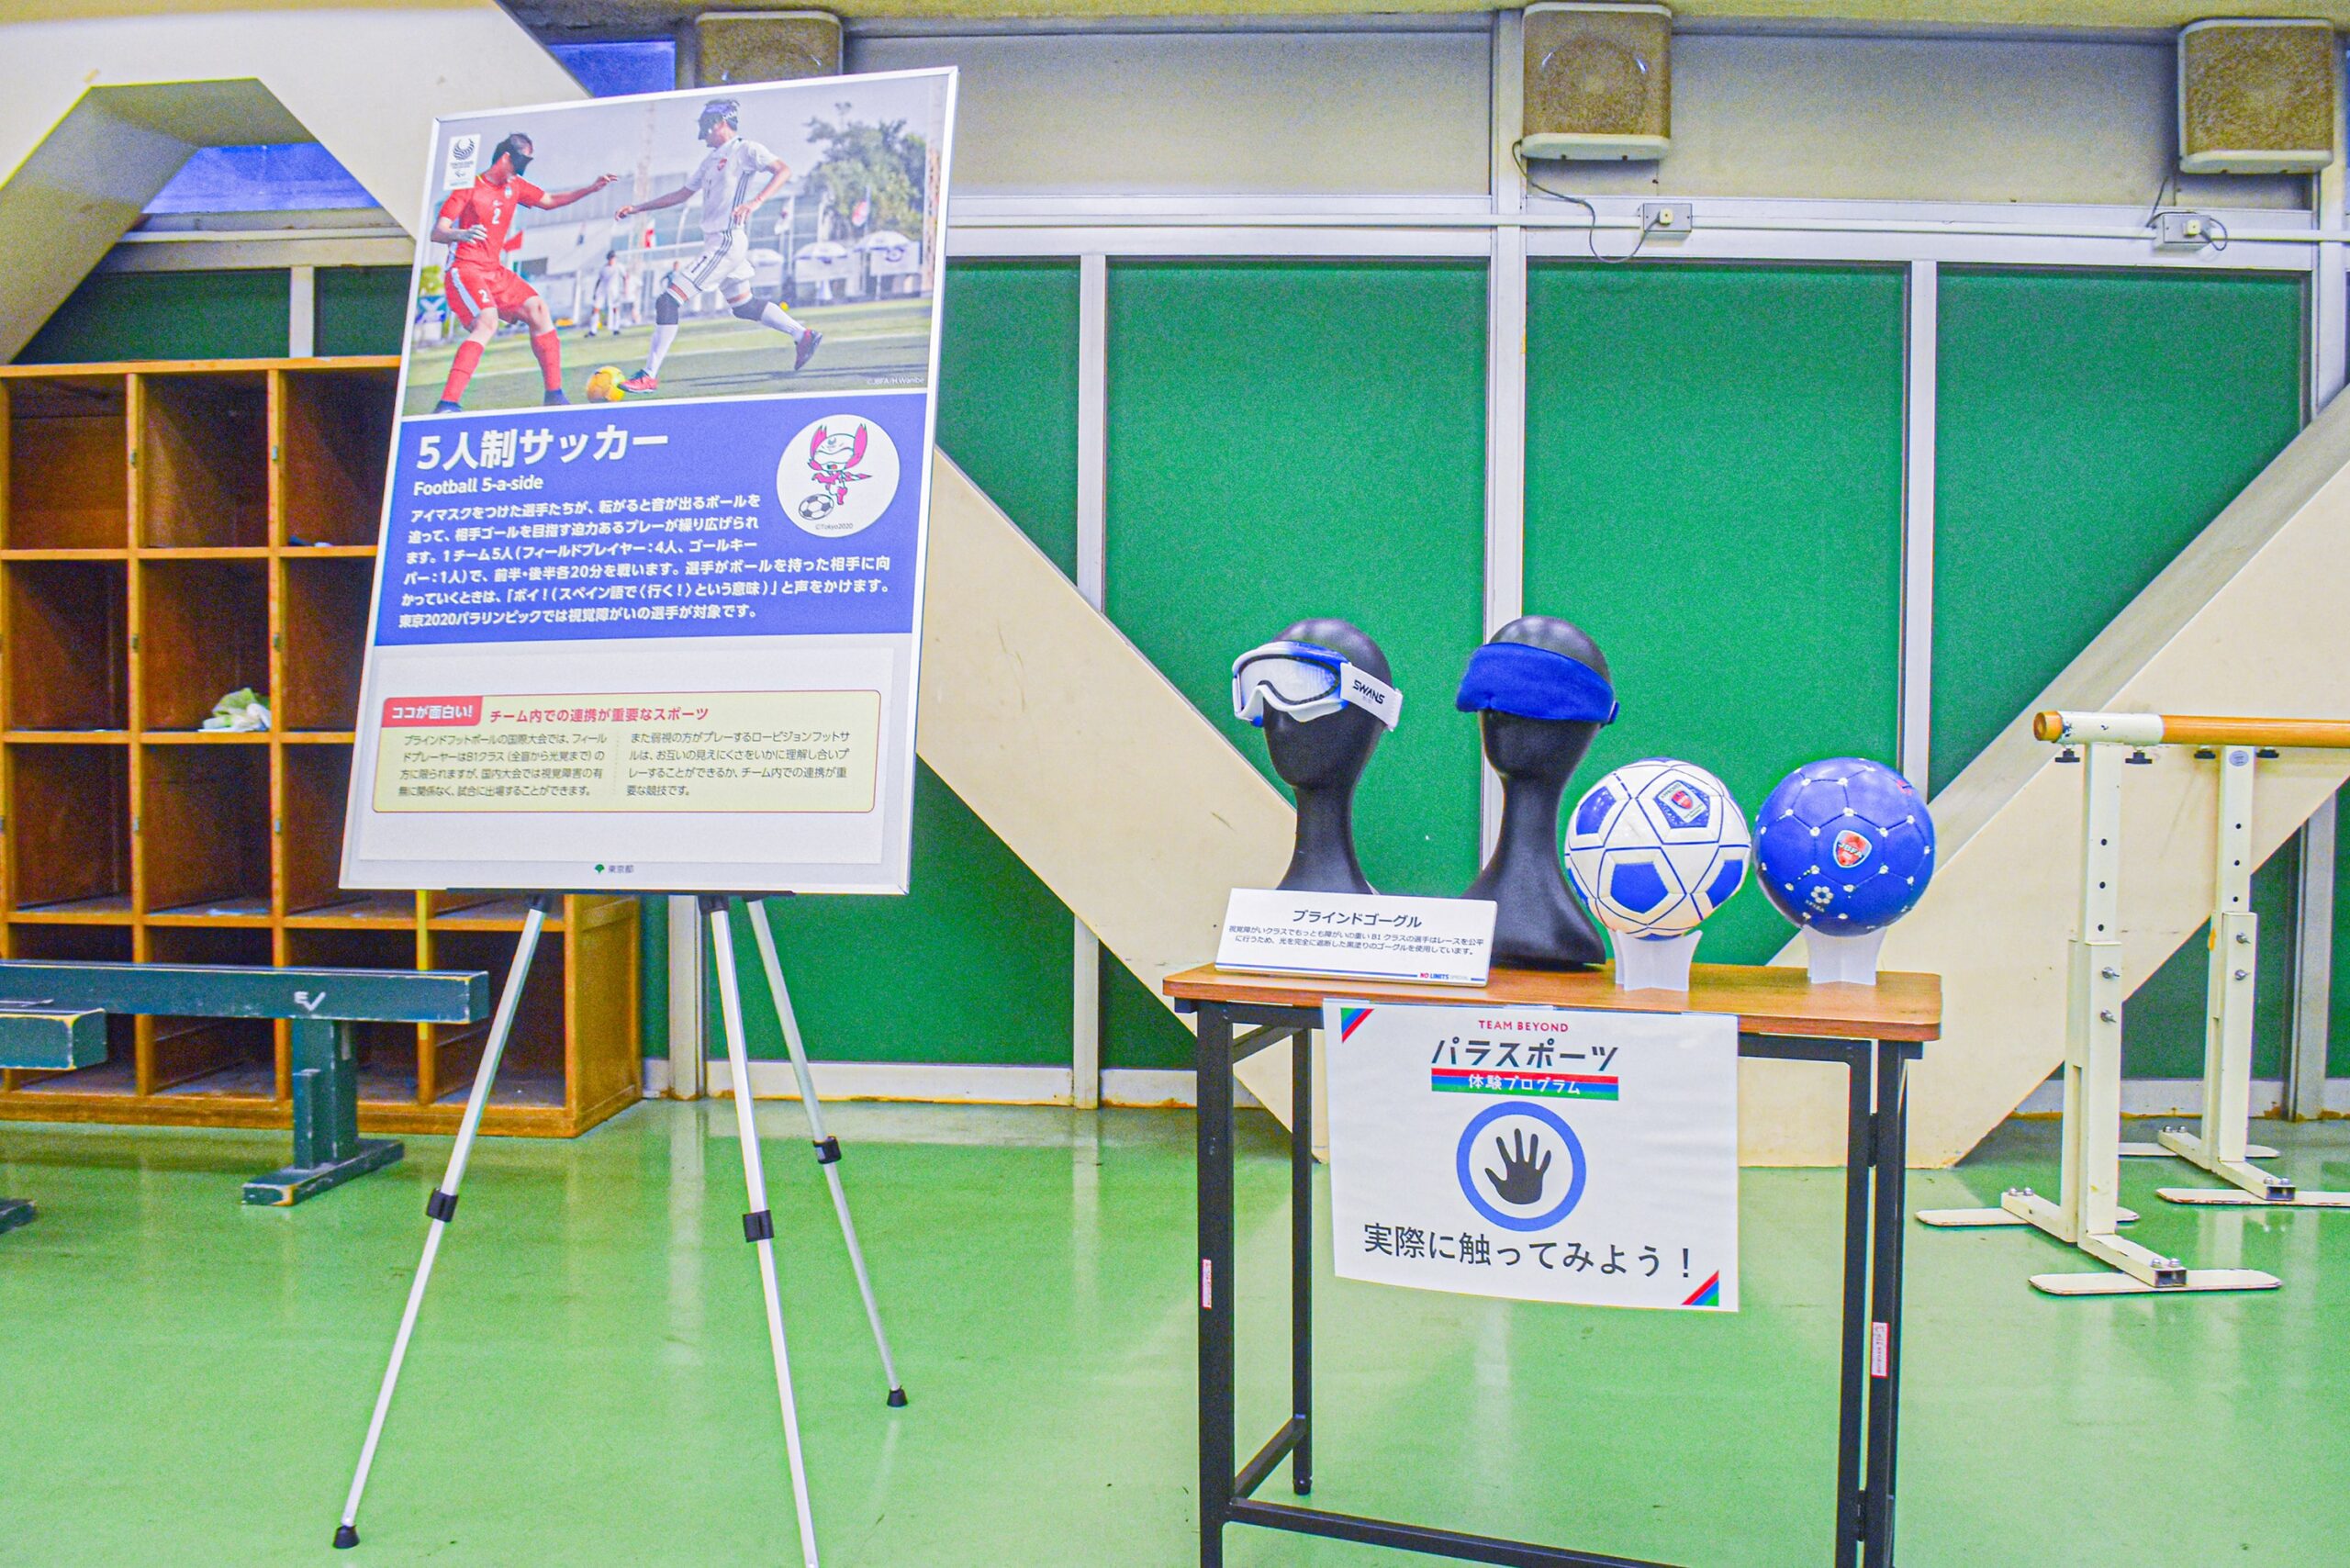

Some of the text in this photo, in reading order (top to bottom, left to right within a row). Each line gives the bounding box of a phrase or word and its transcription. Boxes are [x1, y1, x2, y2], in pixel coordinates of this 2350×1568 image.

[416, 424, 668, 471] 5人制サッカー
[413, 475, 544, 496] Football 5-a-side
[411, 494, 761, 523] アイマスクをつけた選手たちが、転がると音が出るボールを
[408, 516, 759, 544] 追って、相手ゴールを目指す迫力あるプレーが繰り広げられ
[398, 603, 756, 628] 東京2020パラリンピックでは視覚障がいの選手が対象です。
[1353, 679, 1385, 705] SWANS
[490, 707, 710, 723] チーム内での連携が重要なスポーツ
[631, 731, 851, 744] また弱視の方がプレーするロービジョンフットサ
[629, 748, 850, 761] ルは、お互いの見えにくさをいかに理解し合いプ
[629, 767, 847, 778] レーすることができるか、チーム内での連携が重
[626, 784, 690, 796] 要な競技です。
[608, 865, 634, 873] 東京都
[1292, 909, 1423, 928] ブラインドゴーグル
[1478, 1020, 1569, 1033] TEAM BEYOND
[1431, 1036, 1618, 1071] パラスポーツ
[1469, 1074, 1581, 1095] 体験プログラム
[1363, 1222, 1691, 1278] 実際に触ってみよう！
